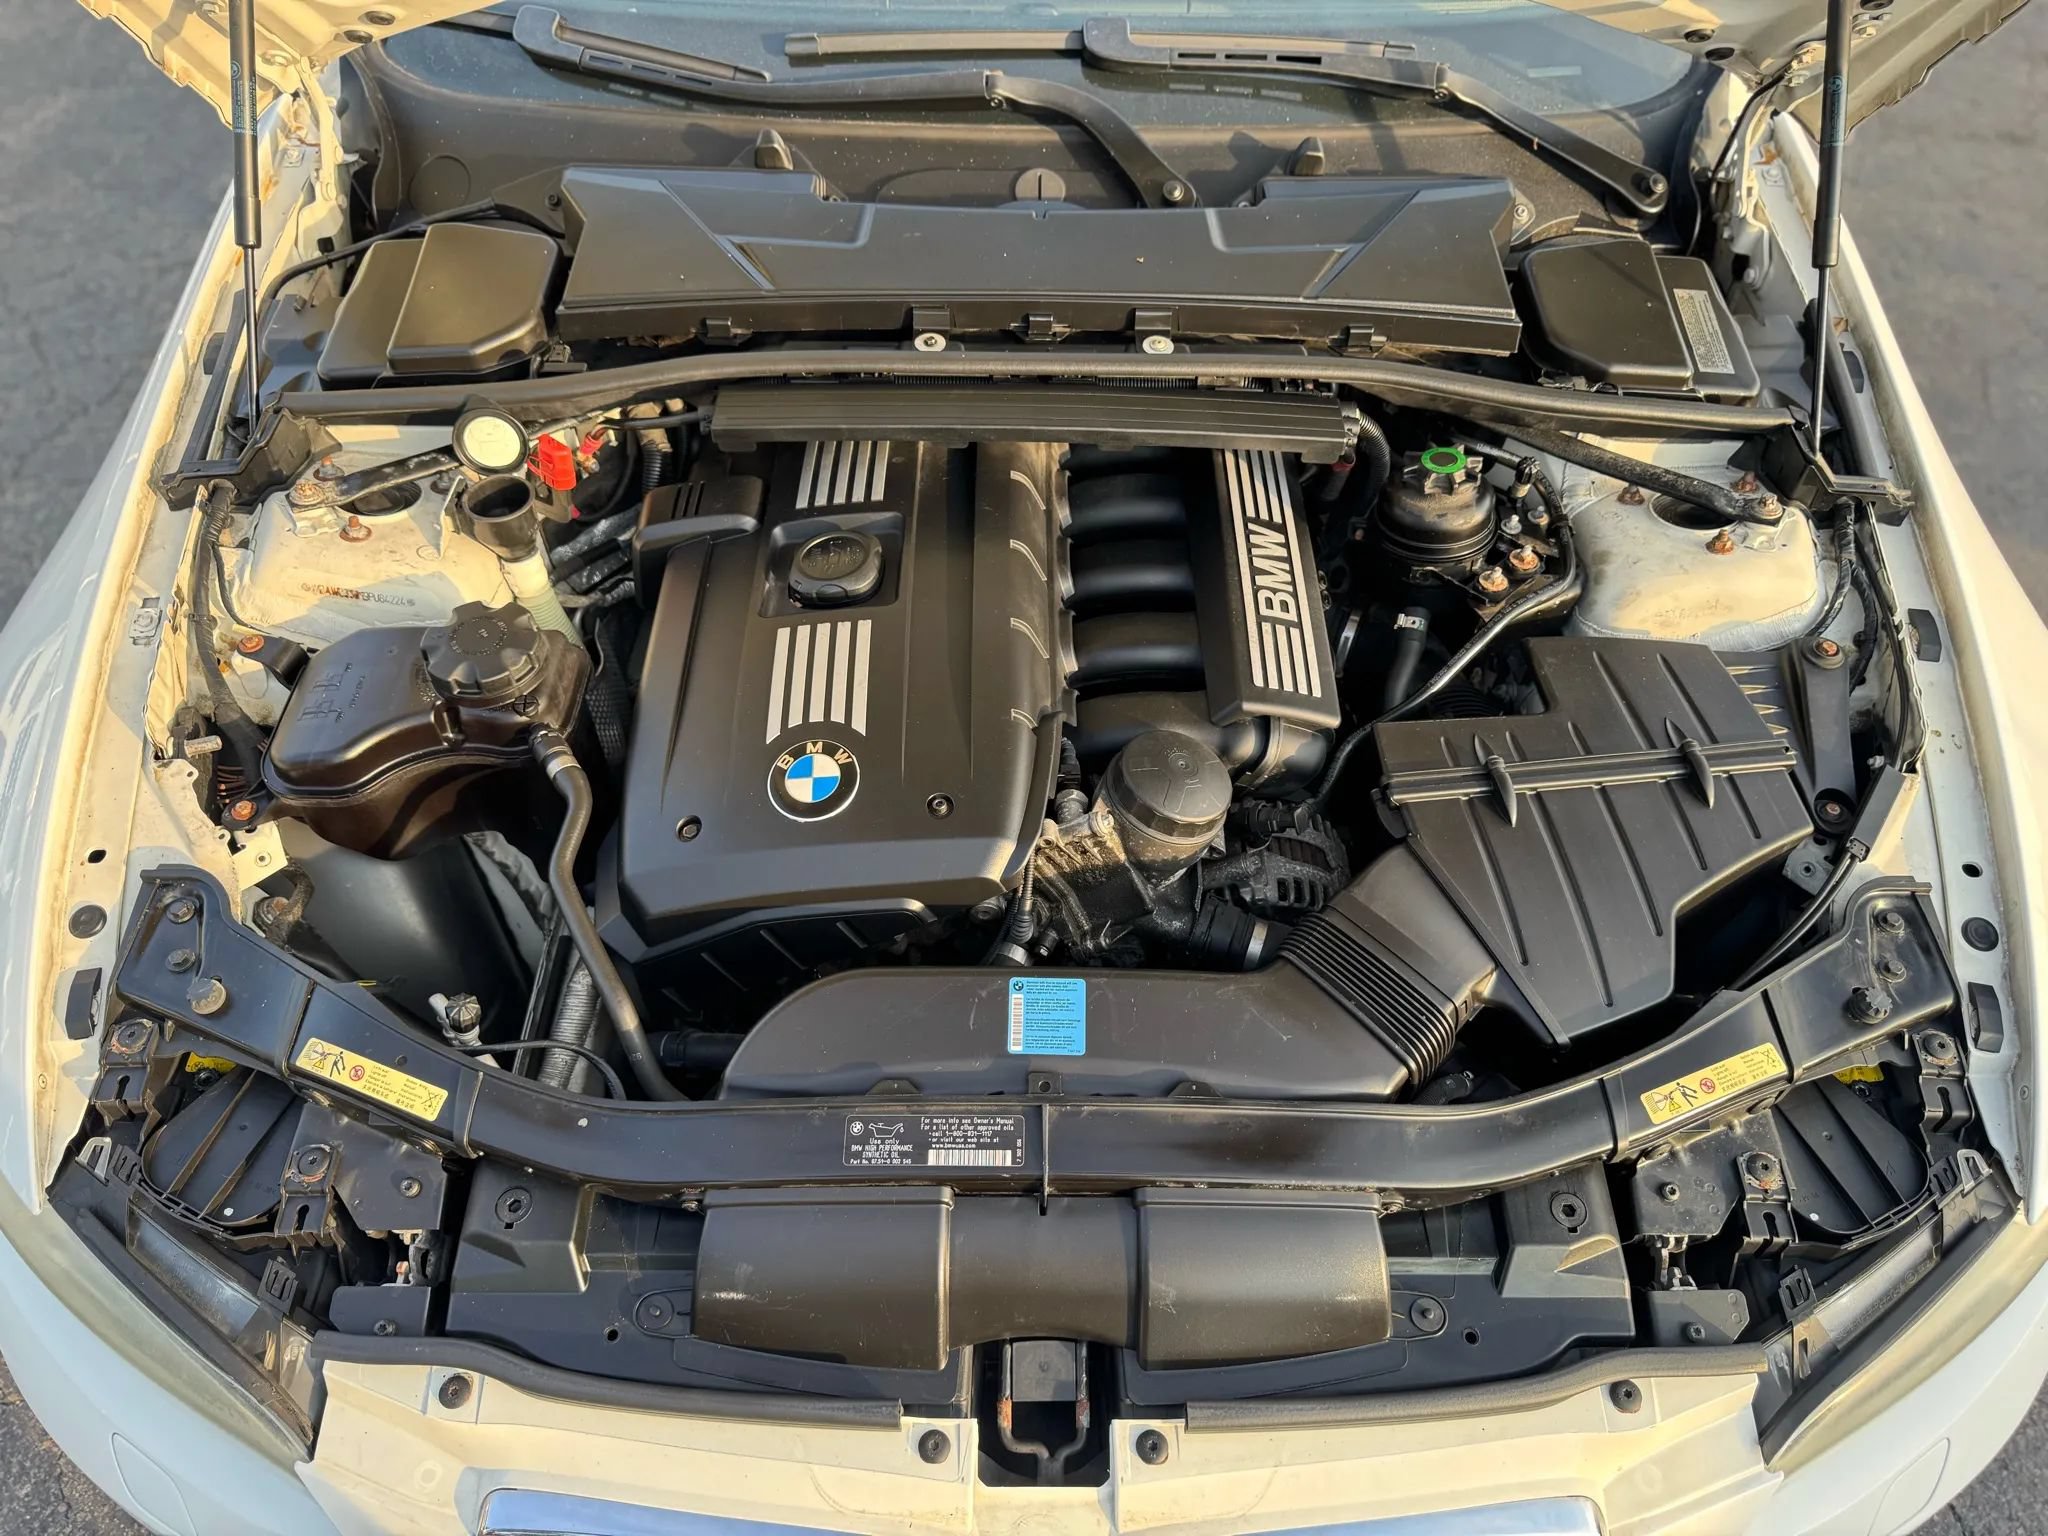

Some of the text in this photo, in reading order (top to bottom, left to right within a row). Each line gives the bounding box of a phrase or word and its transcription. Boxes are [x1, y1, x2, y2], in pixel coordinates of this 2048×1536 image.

[1247, 522, 1298, 622] BMW
[777, 742, 853, 770] BMW
[977, 1124, 1001, 1132] approved
